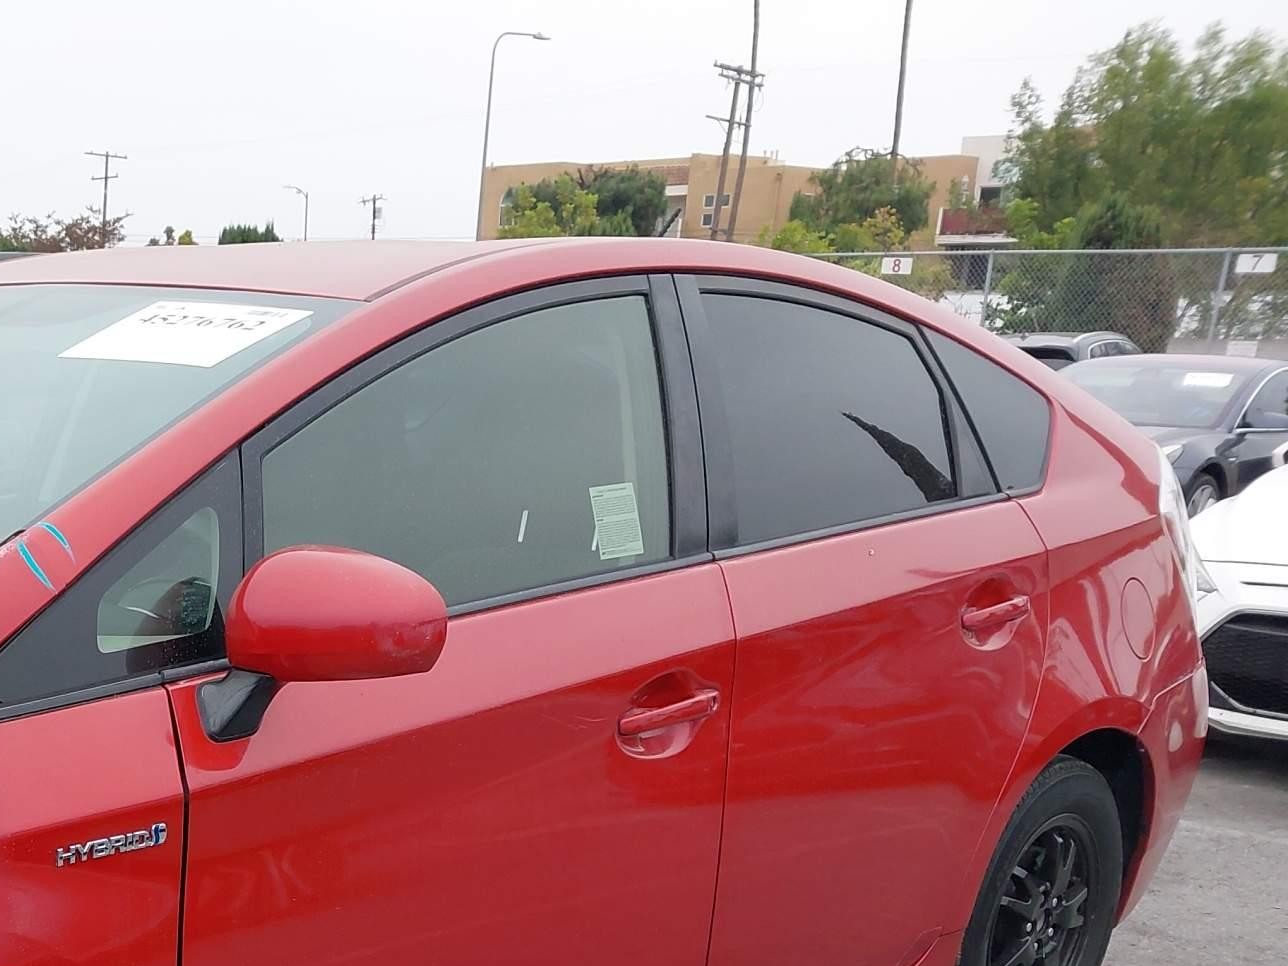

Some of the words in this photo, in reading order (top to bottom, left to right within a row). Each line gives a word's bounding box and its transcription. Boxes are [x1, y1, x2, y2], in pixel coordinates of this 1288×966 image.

[892, 258, 902, 273] 8
[1251, 254, 1265, 272] 7
[139, 313, 266, 331] 45276762
[56, 830, 152, 867] HYBRID
